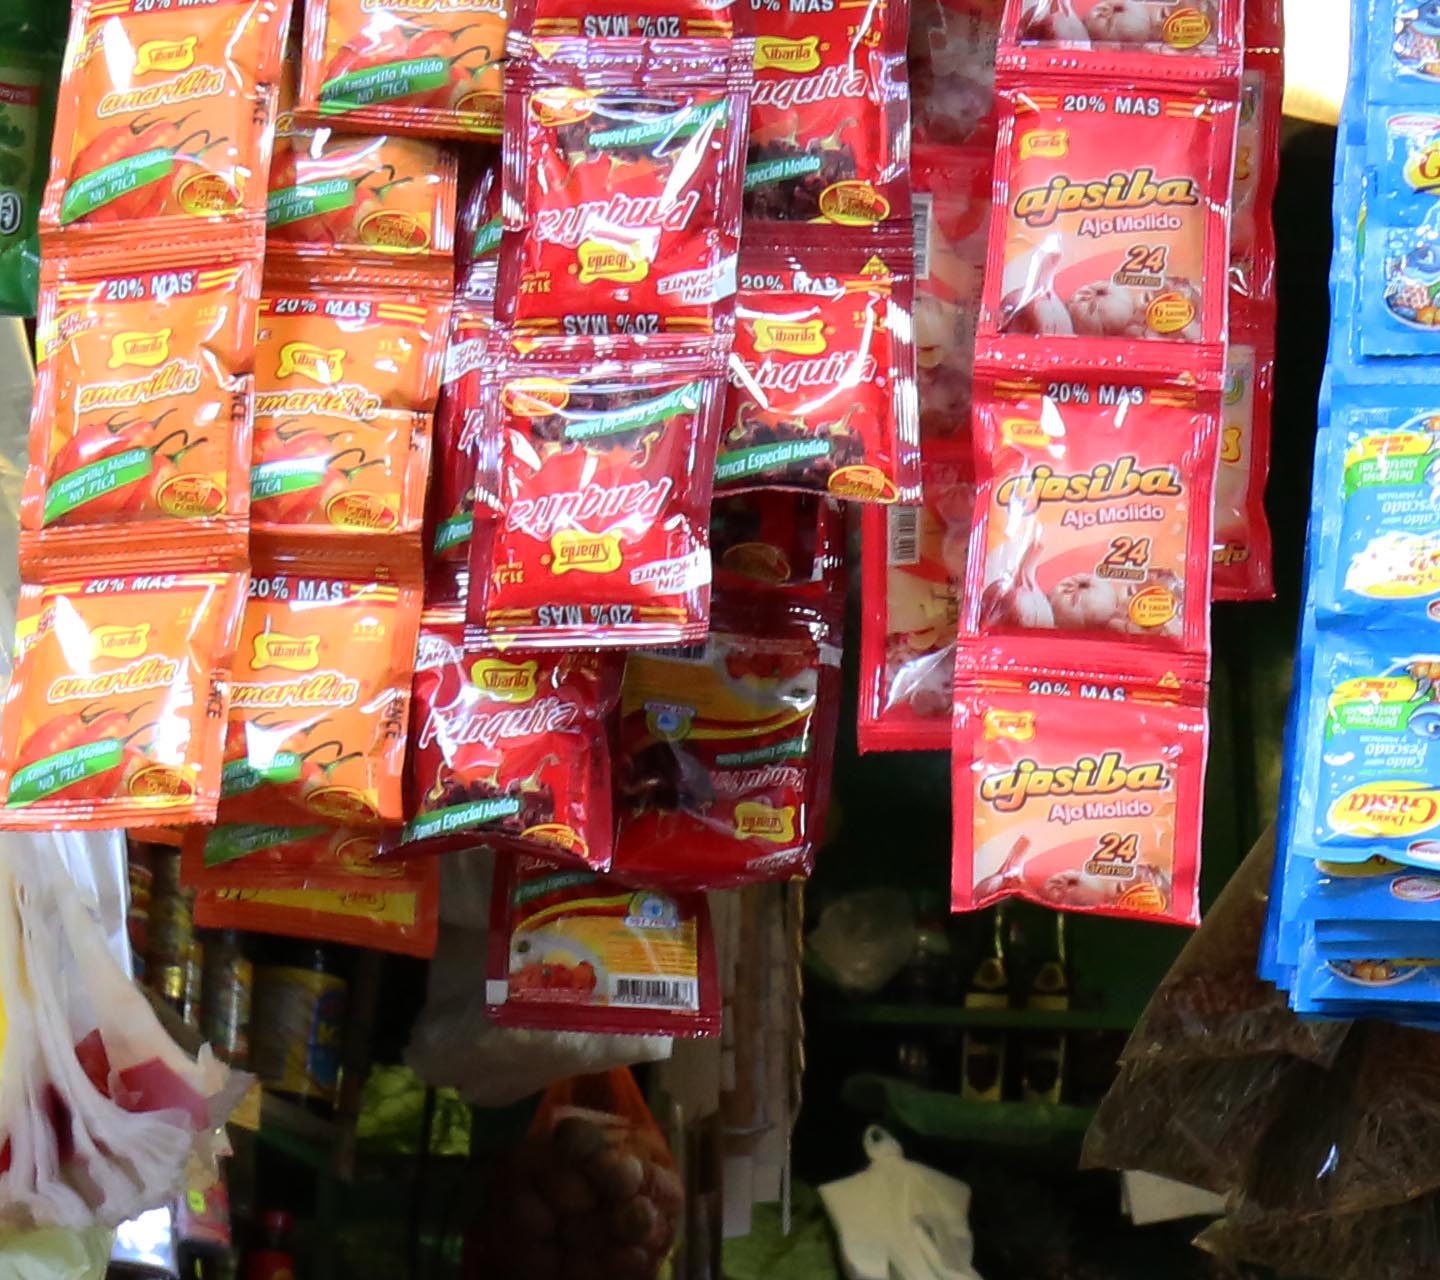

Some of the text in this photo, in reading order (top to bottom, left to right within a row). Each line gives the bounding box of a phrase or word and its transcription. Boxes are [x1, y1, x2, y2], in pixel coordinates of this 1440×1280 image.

[584, 15, 680, 37] 20% MAS
[399, 59, 444, 80] Molido
[377, 80, 410, 98] PICA
[1063, 96, 1160, 116] 20% MAS
[89, 177, 137, 205] NO PICA
[1015, 169, 1198, 226] ajosiba
[1079, 216, 1181, 238] Ajo Molido
[1123, 246, 1166, 272] 24
[107, 272, 194, 300] 20% MAS
[275, 298, 371, 317] 20% MAS
[563, 314, 659, 336] 20% MAS
[1048, 383, 1145, 406] 20% MAS
[748, 438, 831, 473] Especial Molido
[89, 478, 116, 496] PICA
[1061, 505, 1165, 528] Ajo Molido
[1109, 536, 1150, 565] 24
[85, 577, 125, 593] 20%
[248, 580, 344, 601] 20% MAS
[538, 604, 633, 627] 20% MAS
[981, 753, 1170, 812] ajosiba
[1048, 801, 1153, 825] Ajo Molido
[1095, 833, 1138, 863] 24
